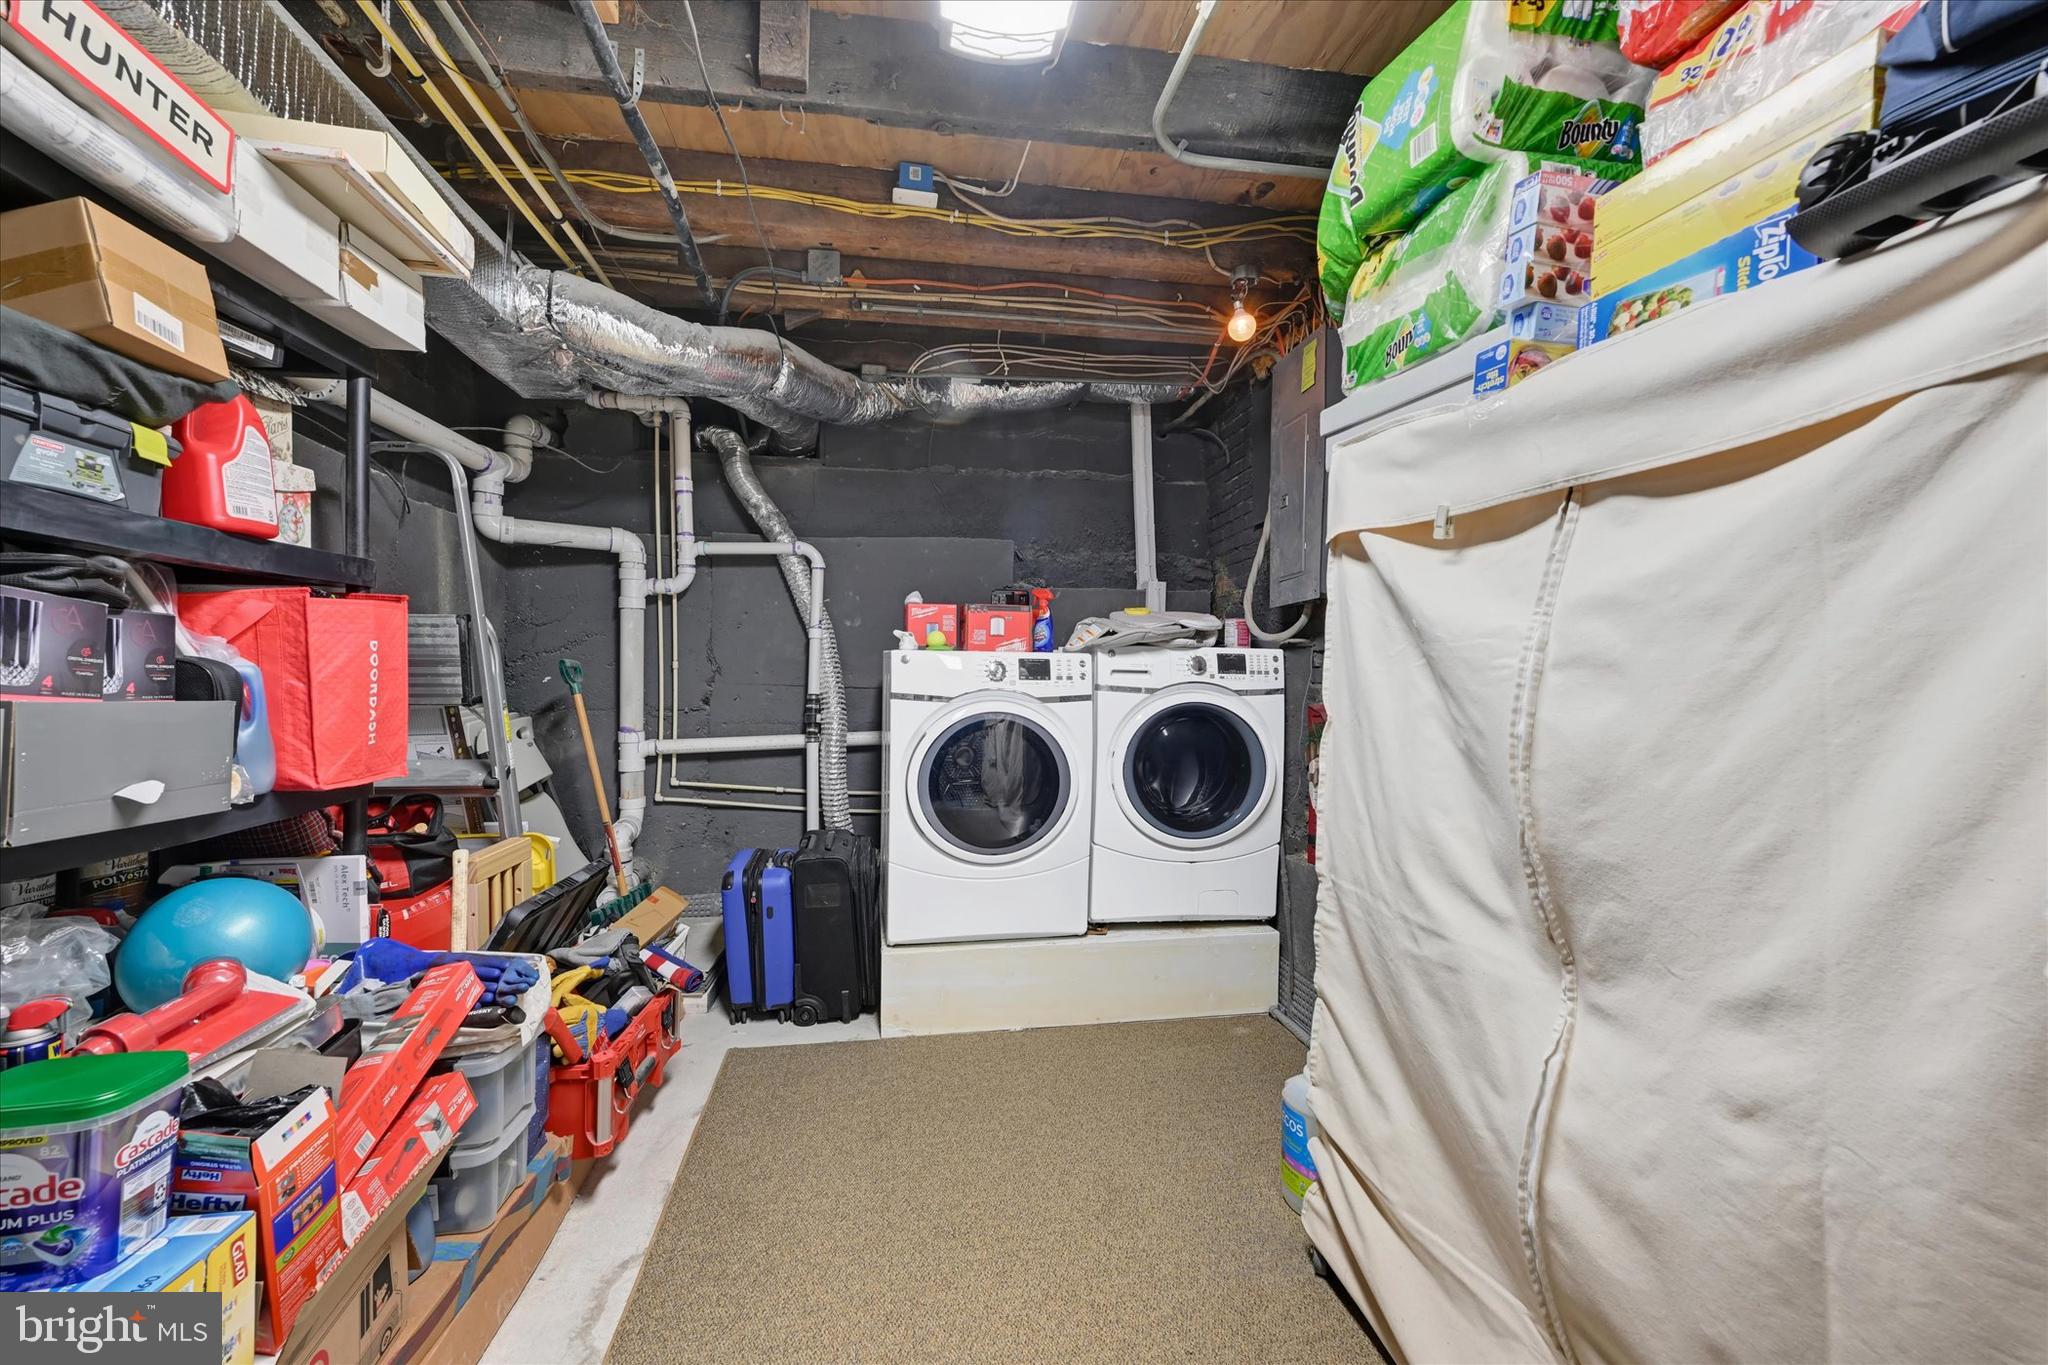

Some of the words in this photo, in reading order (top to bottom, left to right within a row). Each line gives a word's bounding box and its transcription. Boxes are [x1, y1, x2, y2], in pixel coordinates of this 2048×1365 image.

[42, 0, 214, 158] HUNTER
[1558, 116, 1620, 150] Bounty
[41, 675, 54, 688] 4
[126, 682, 136, 692] 4
[92, 873, 128, 888] POLY
[340, 864, 349, 885] Alex
[114, 1116, 180, 1168] Cascade
[116, 1147, 158, 1180] PLATINUM
[183, 1169, 220, 1181] Hefty
[171, 1194, 241, 1212] Hefty
[27, 1209, 75, 1228] PLUS
[231, 1240, 246, 1282] GLAD
